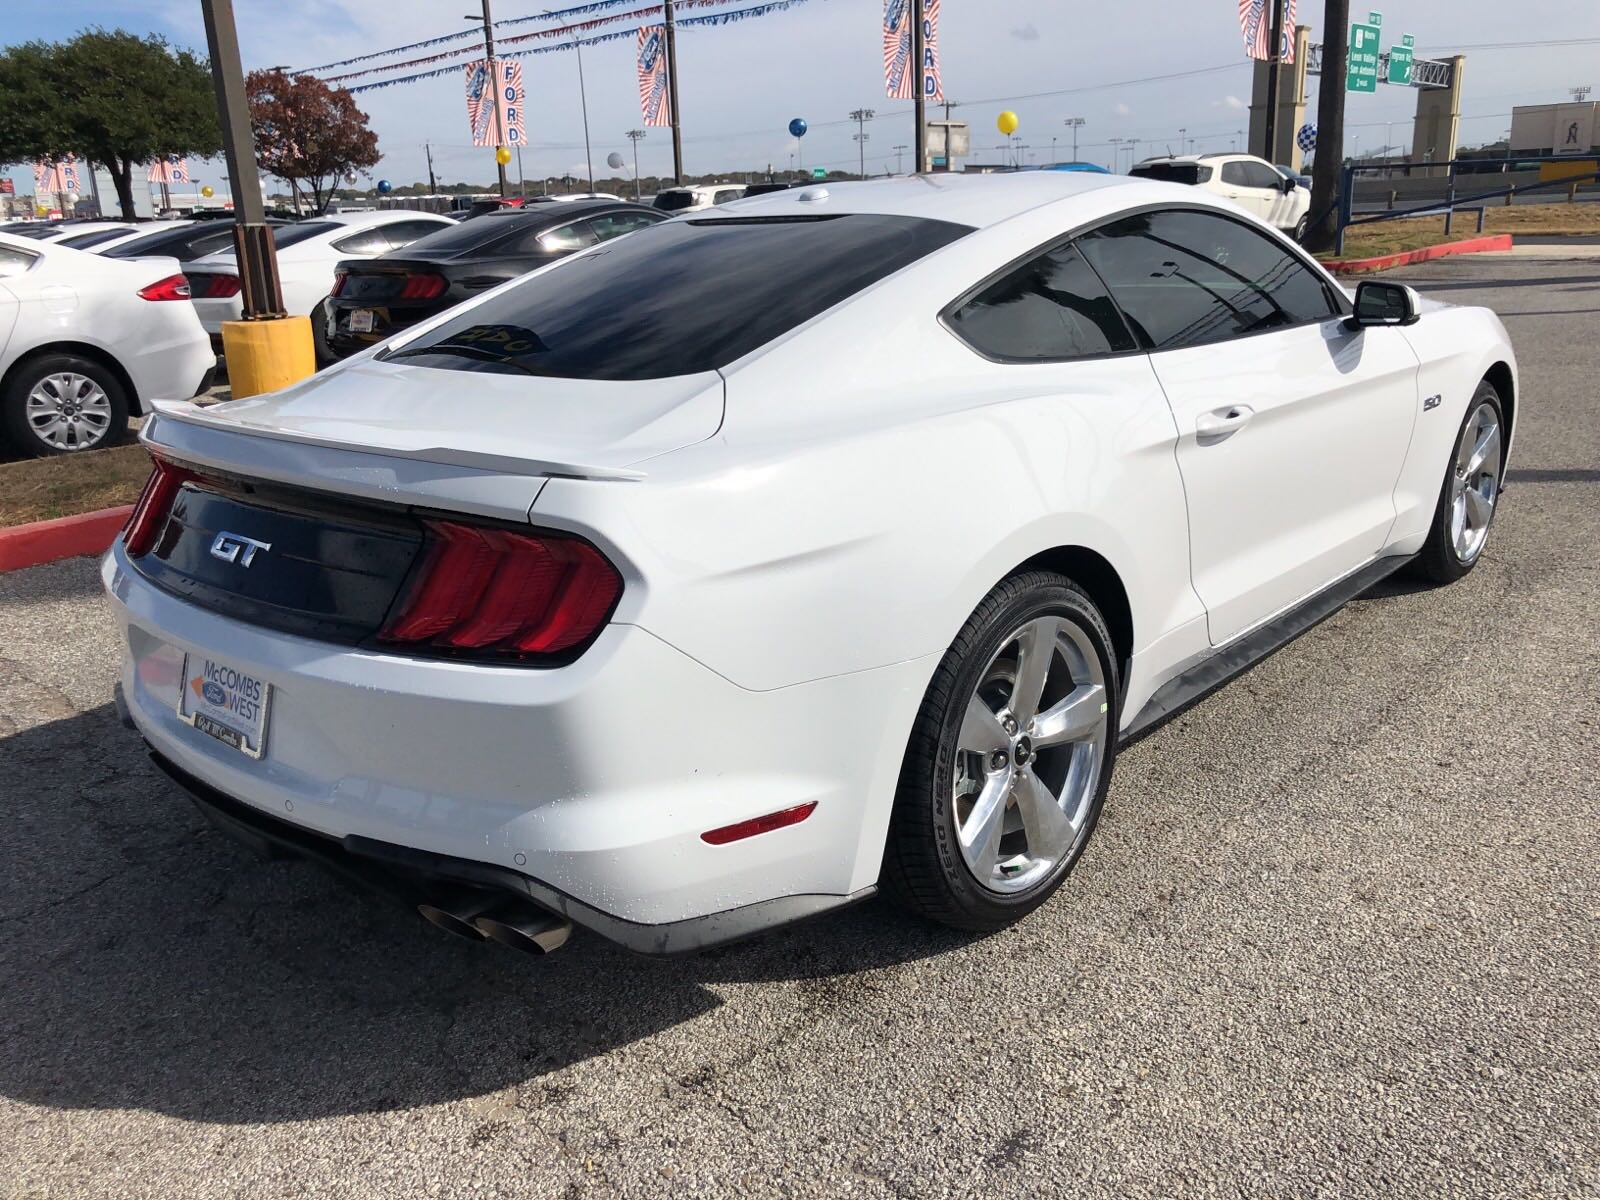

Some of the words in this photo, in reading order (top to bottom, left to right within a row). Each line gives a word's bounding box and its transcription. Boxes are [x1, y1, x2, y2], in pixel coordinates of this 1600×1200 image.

[504, 66, 519, 142] FORD
[210, 531, 272, 569] GT
[204, 660, 261, 701] McCOMBS
[229, 694, 260, 722] WEST
[935, 743, 948, 817] NERO
[937, 824, 959, 882] ZERO
